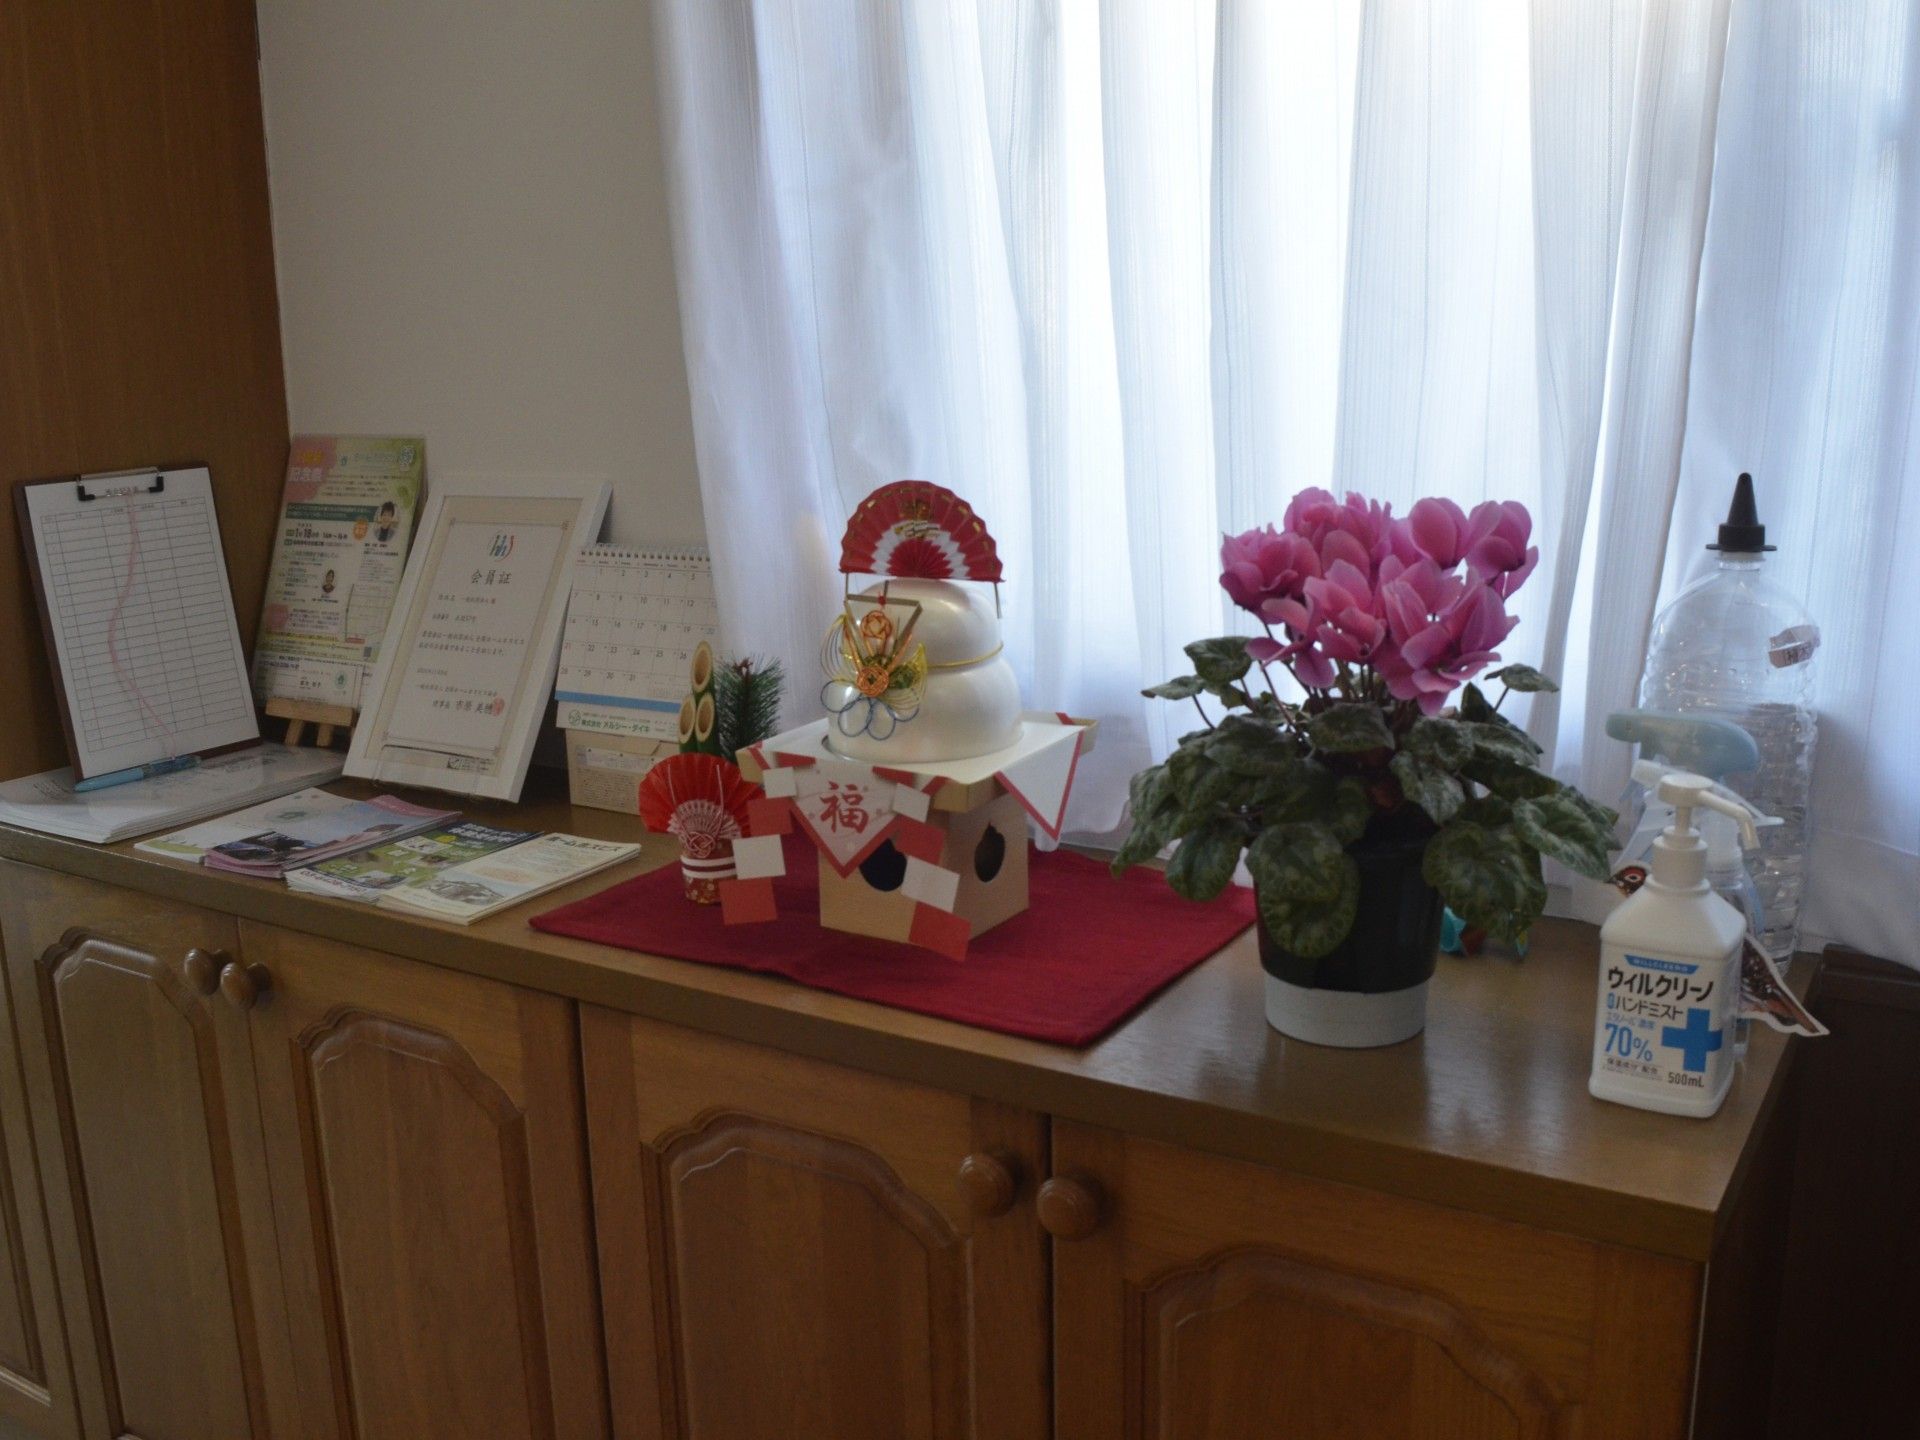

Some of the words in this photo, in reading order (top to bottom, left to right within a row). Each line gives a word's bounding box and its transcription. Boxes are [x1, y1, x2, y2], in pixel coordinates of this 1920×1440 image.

[471, 568, 512, 585] 会員証
[820, 781, 869, 833] 福
[1616, 995, 1683, 1020] ハンドミスト
[1605, 1022, 1653, 1062] 70%
[1668, 1072, 1704, 1088] 500mL
